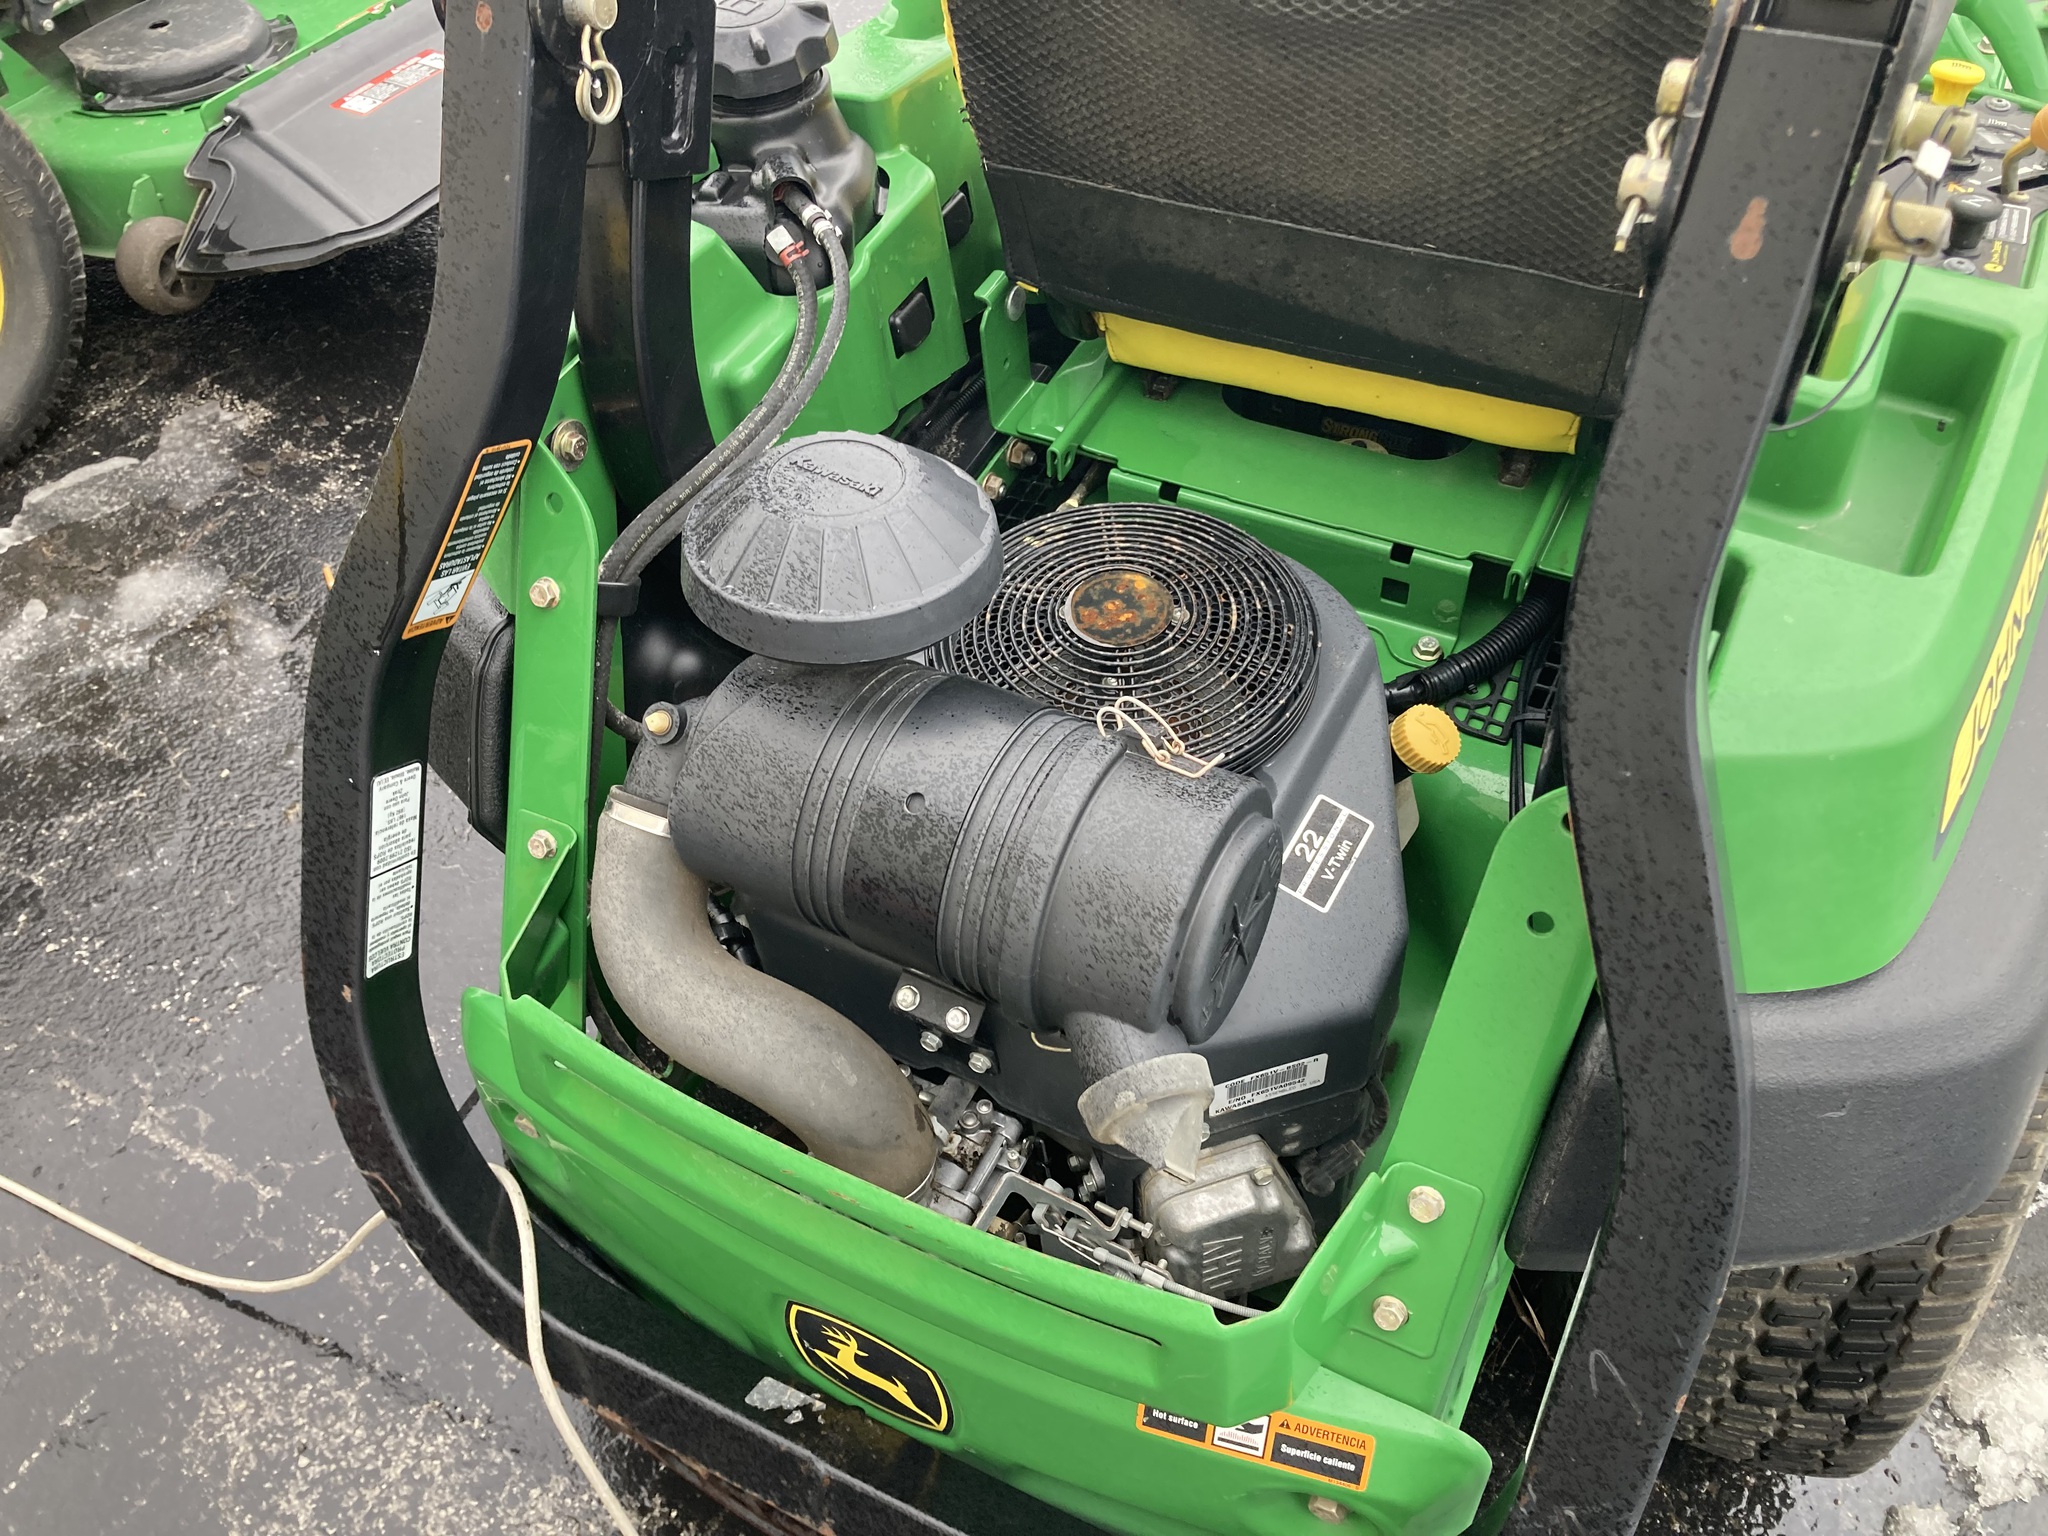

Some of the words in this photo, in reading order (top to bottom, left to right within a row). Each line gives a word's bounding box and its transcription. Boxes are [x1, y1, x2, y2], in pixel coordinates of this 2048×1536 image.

[789, 459, 883, 498] Kawasaki
[655, 514, 664, 524] 1/4
[665, 501, 678, 514] SAE
[679, 486, 694, 501] 30R7
[440, 568, 453, 577] LAS
[404, 774, 415, 782] Deere
[386, 796, 397, 804] Deere
[374, 850, 386, 860] ROPS
[1294, 830, 1324, 862] 22
[1298, 812, 1348, 894] PROFESSIONAL
[1320, 839, 1353, 880] V-Twin
[391, 936, 410, 950] CONTRA
[1225, 1080, 1246, 1089] CODE
[1215, 1098, 1255, 1114] KAWASAKI
[1228, 1096, 1246, 1104] E/NO
[1152, 1408, 1167, 1420] Hot
[1168, 1414, 1199, 1430] surface
[1294, 1422, 1366, 1450] ADVERTENCIA
[1280, 1444, 1322, 1462] Superficie
[1322, 1456, 1356, 1472] caliente
